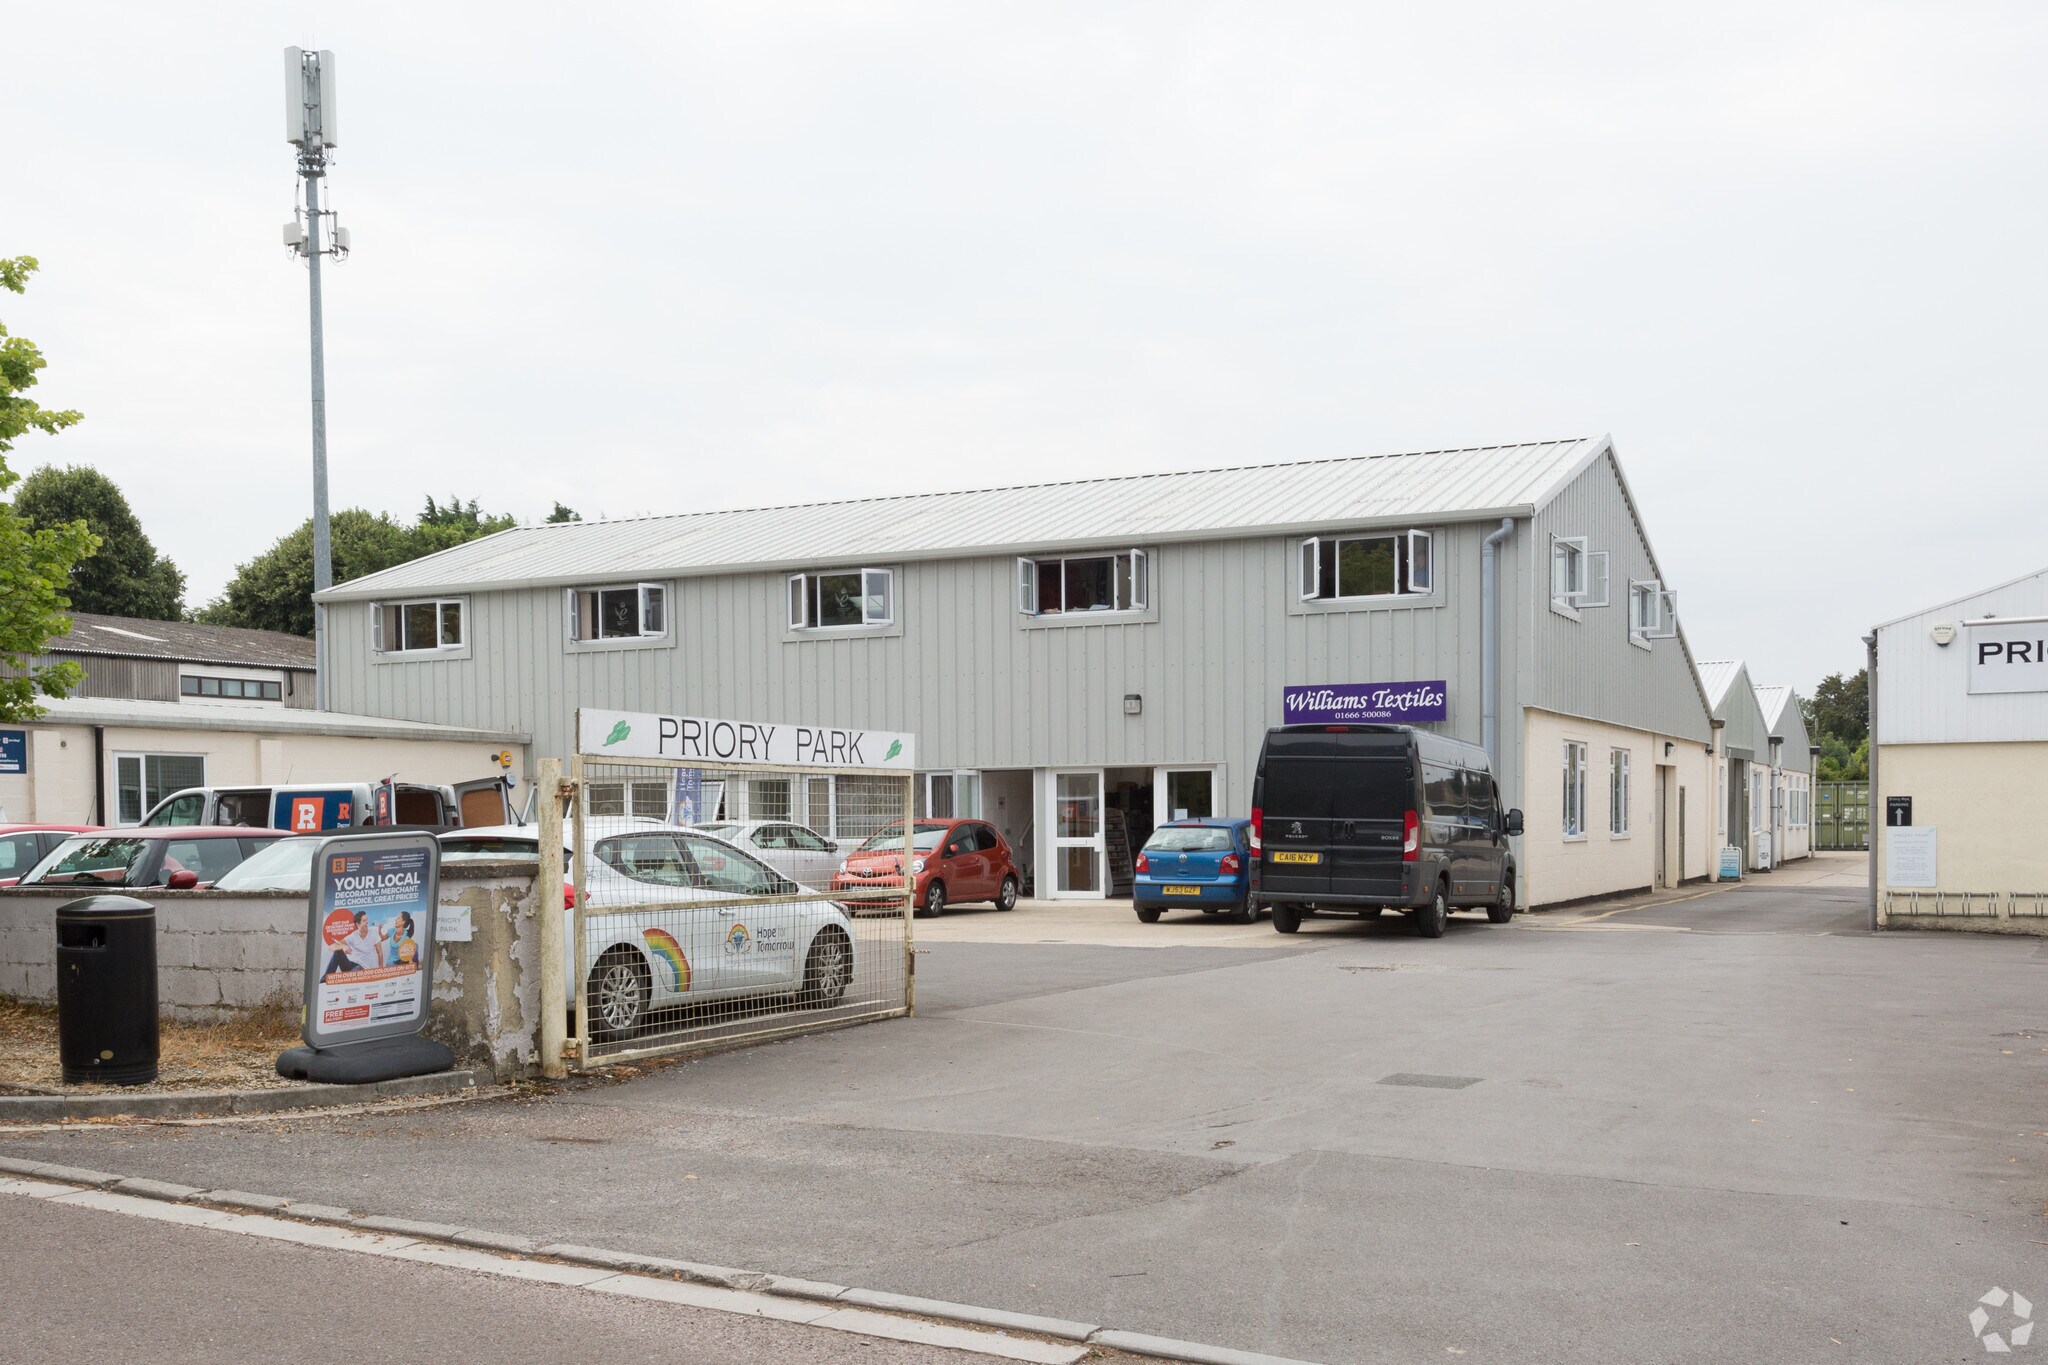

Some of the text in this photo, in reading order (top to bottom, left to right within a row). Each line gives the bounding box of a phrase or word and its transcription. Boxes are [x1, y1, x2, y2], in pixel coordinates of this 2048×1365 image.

[1978, 640, 2048, 665] PRI
[1286, 687, 1444, 712] Williams Textiles
[658, 718, 864, 764] PRIORY PARK
[297, 803, 316, 829] R
[1279, 853, 1296, 861] CA16
[335, 872, 421, 891] YOUR LOCAL
[335, 885, 419, 899] DECORATING MERCHANT.
[374, 895, 395, 903] GREAT
[396, 892, 419, 900] PRICES!
[757, 926, 776, 939] Hope
[757, 941, 795, 952] Tomorrow
[374, 967, 396, 975] COLOURS
[325, 1010, 344, 1018] FREE
